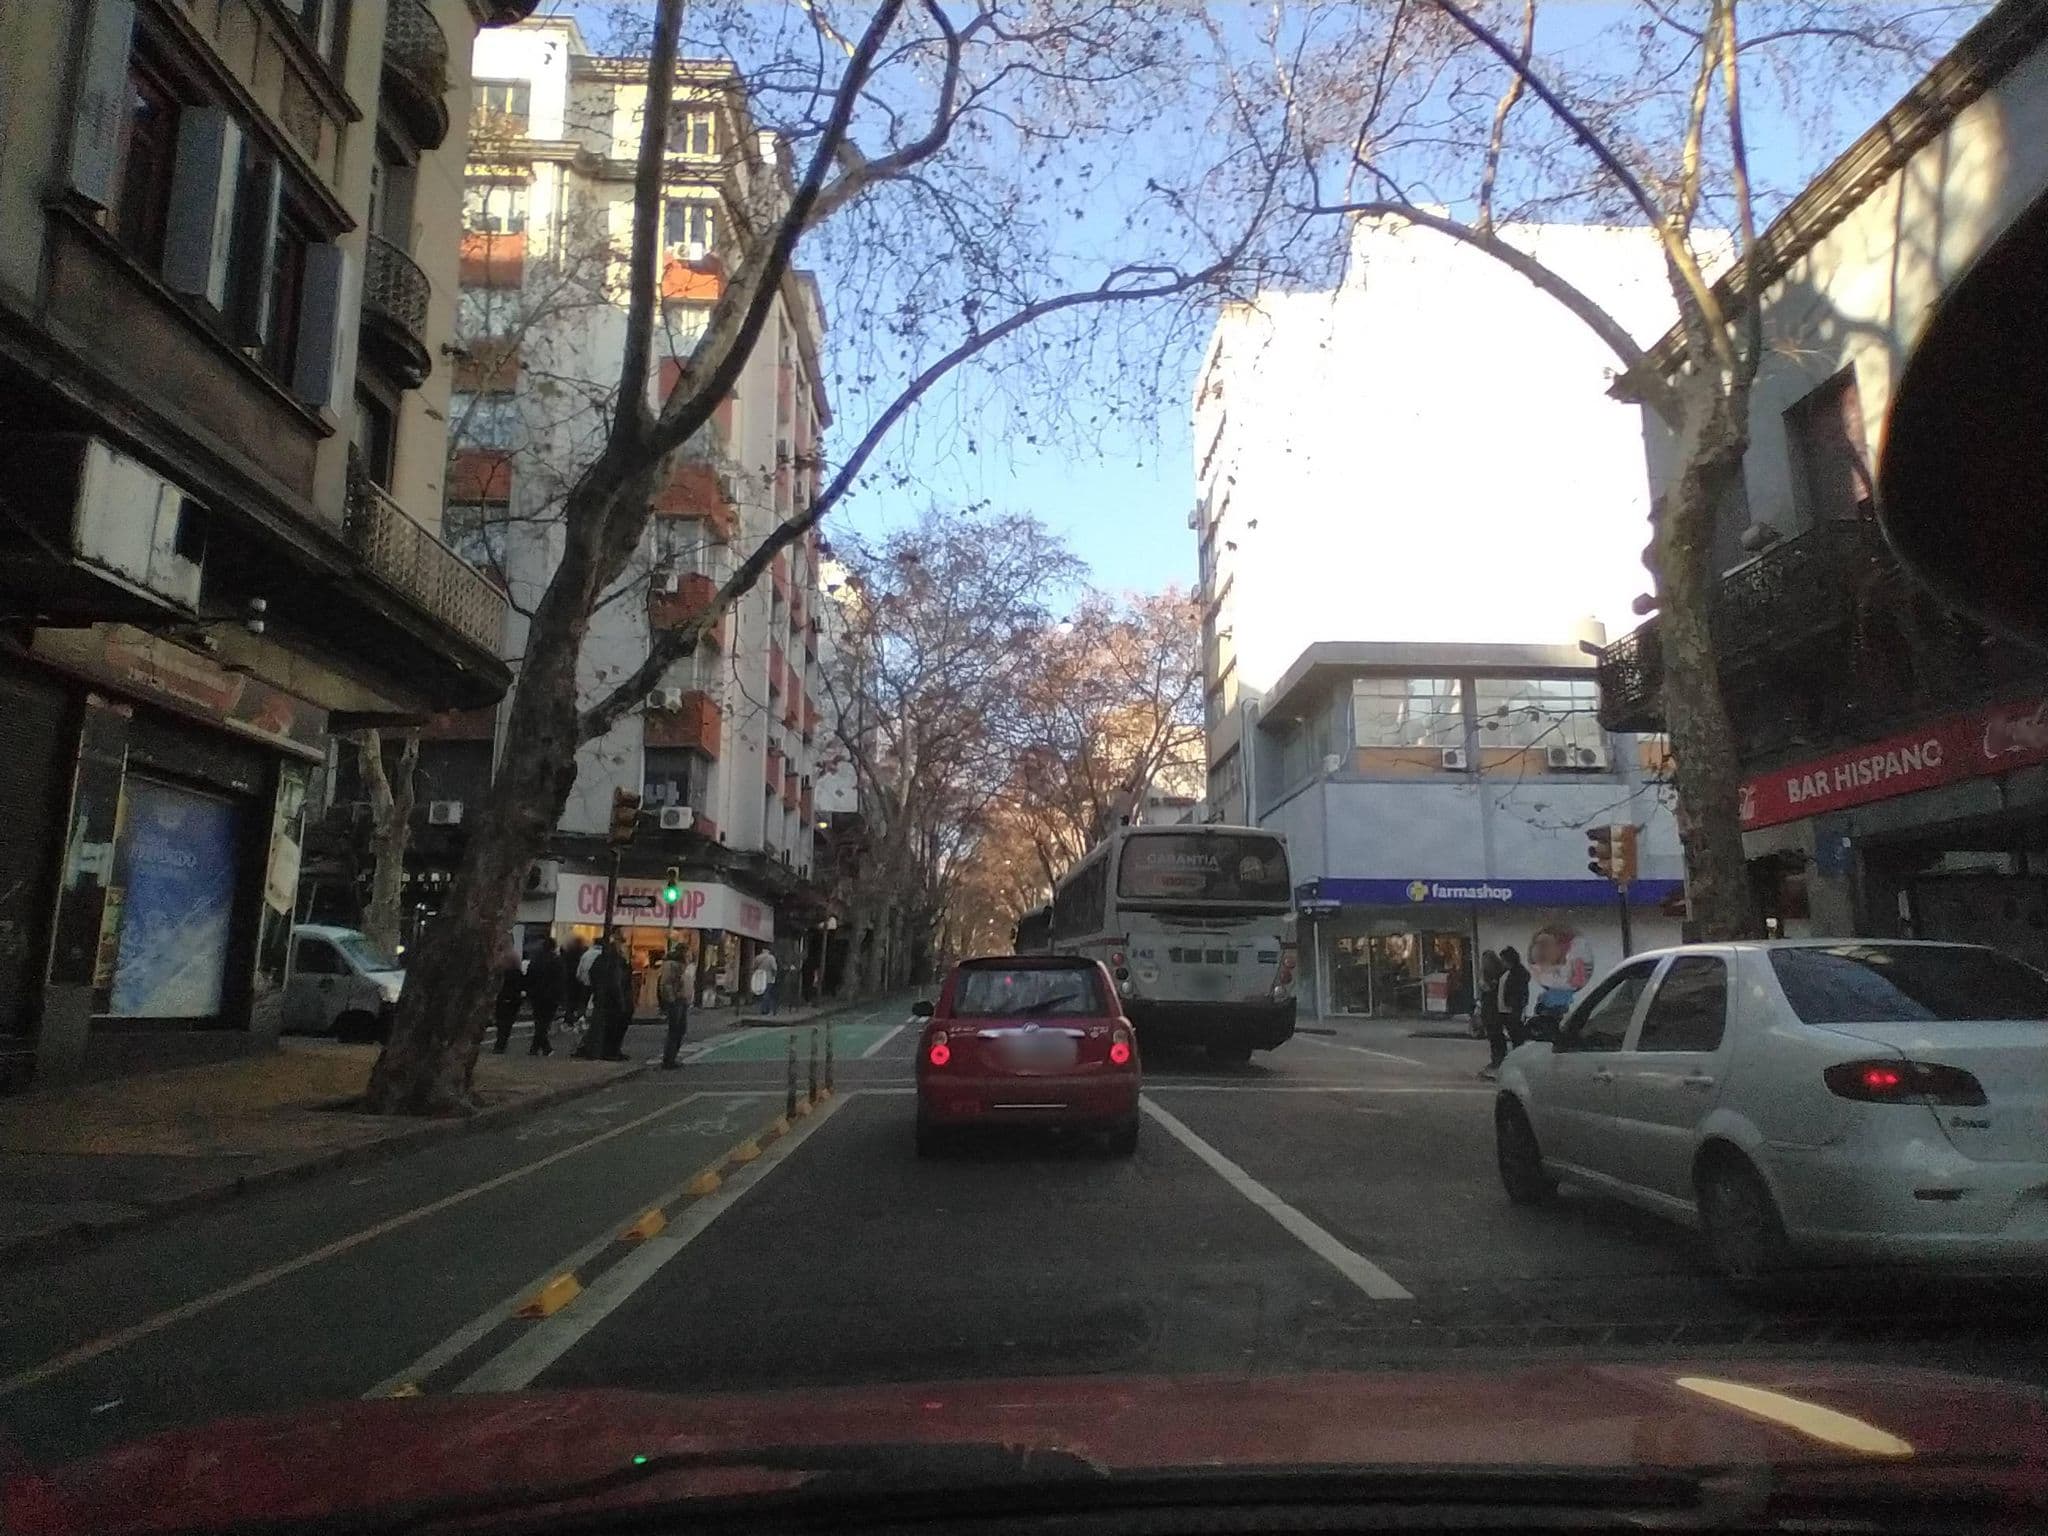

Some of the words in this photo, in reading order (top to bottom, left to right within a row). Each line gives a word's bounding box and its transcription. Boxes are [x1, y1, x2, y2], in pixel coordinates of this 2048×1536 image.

[1787, 769, 1831, 804] BAR
[1835, 740, 1943, 791] HISPANO
[578, 883, 706, 919] COMESHOP
[1432, 883, 1512, 901] farmashop
